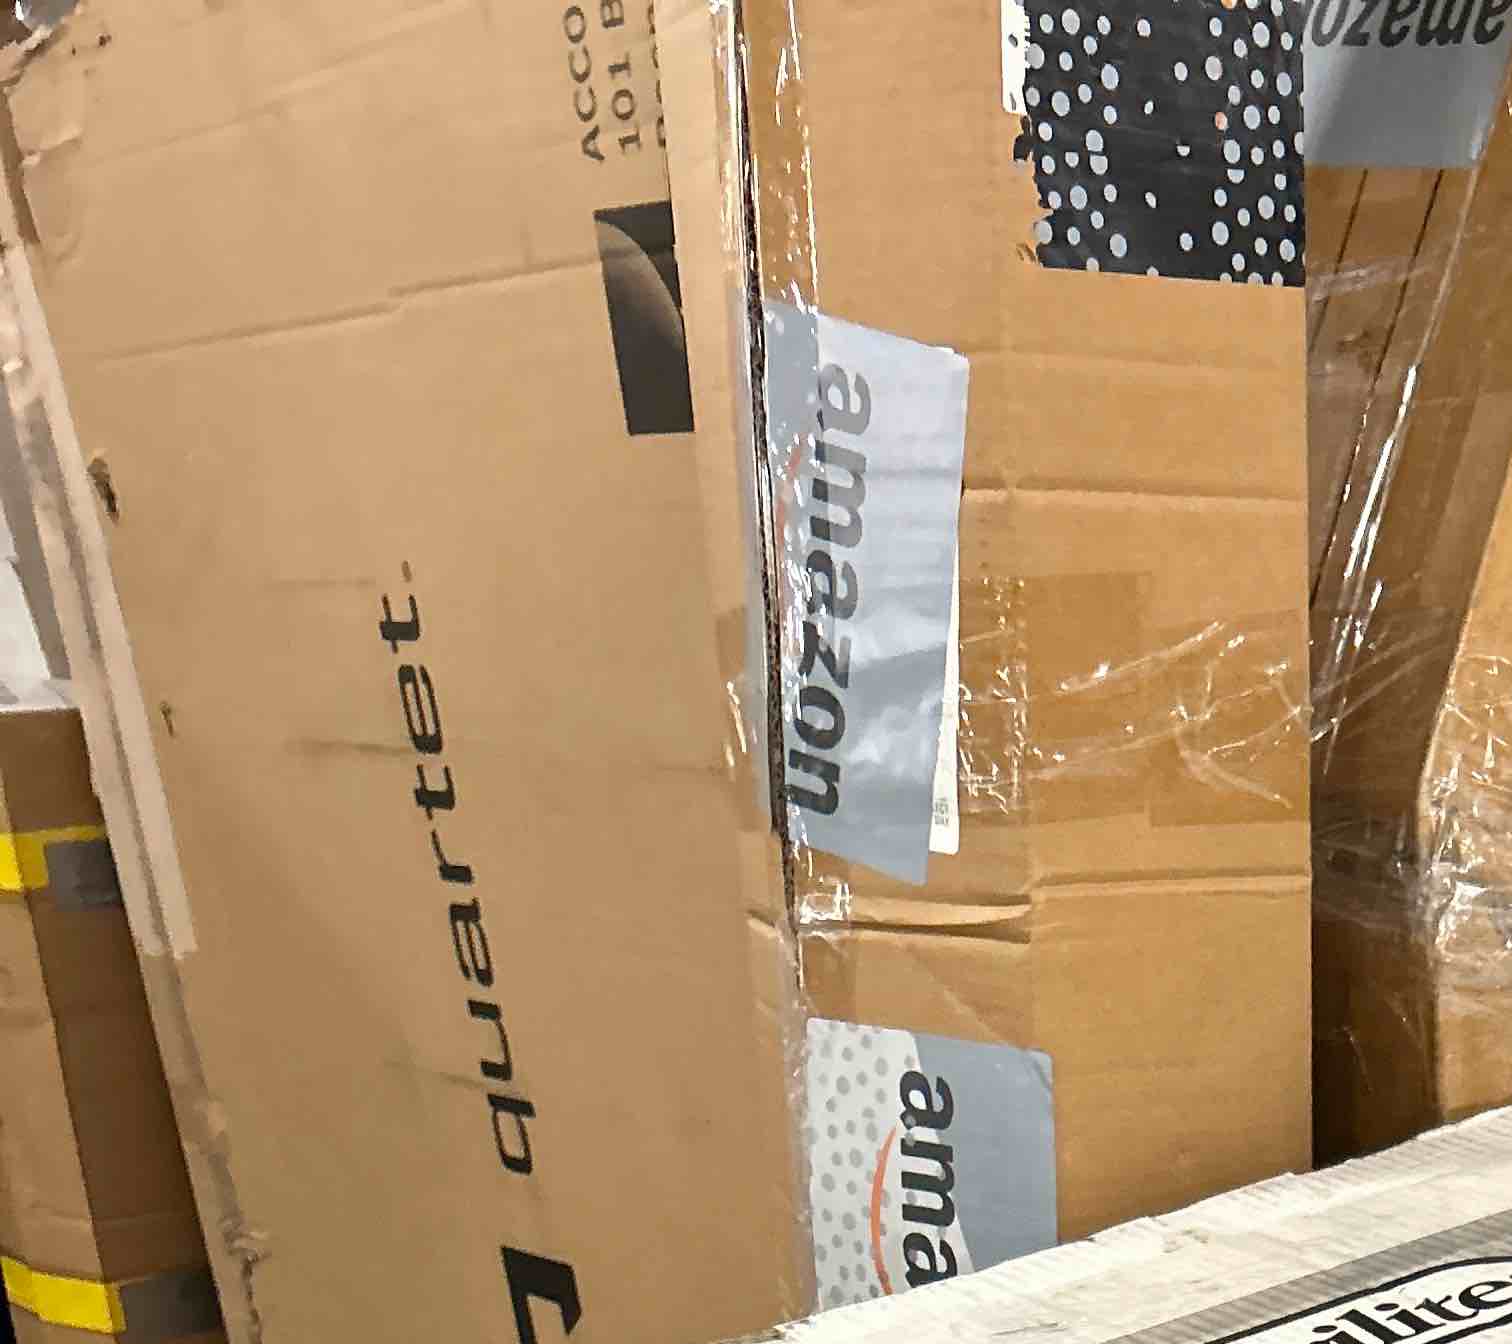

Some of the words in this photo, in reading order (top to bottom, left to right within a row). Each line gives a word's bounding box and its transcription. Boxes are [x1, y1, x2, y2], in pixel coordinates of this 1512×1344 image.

[563, 5, 606, 162] ACCO
[611, 52, 643, 155] 101
[785, 364, 872, 816] amazon
